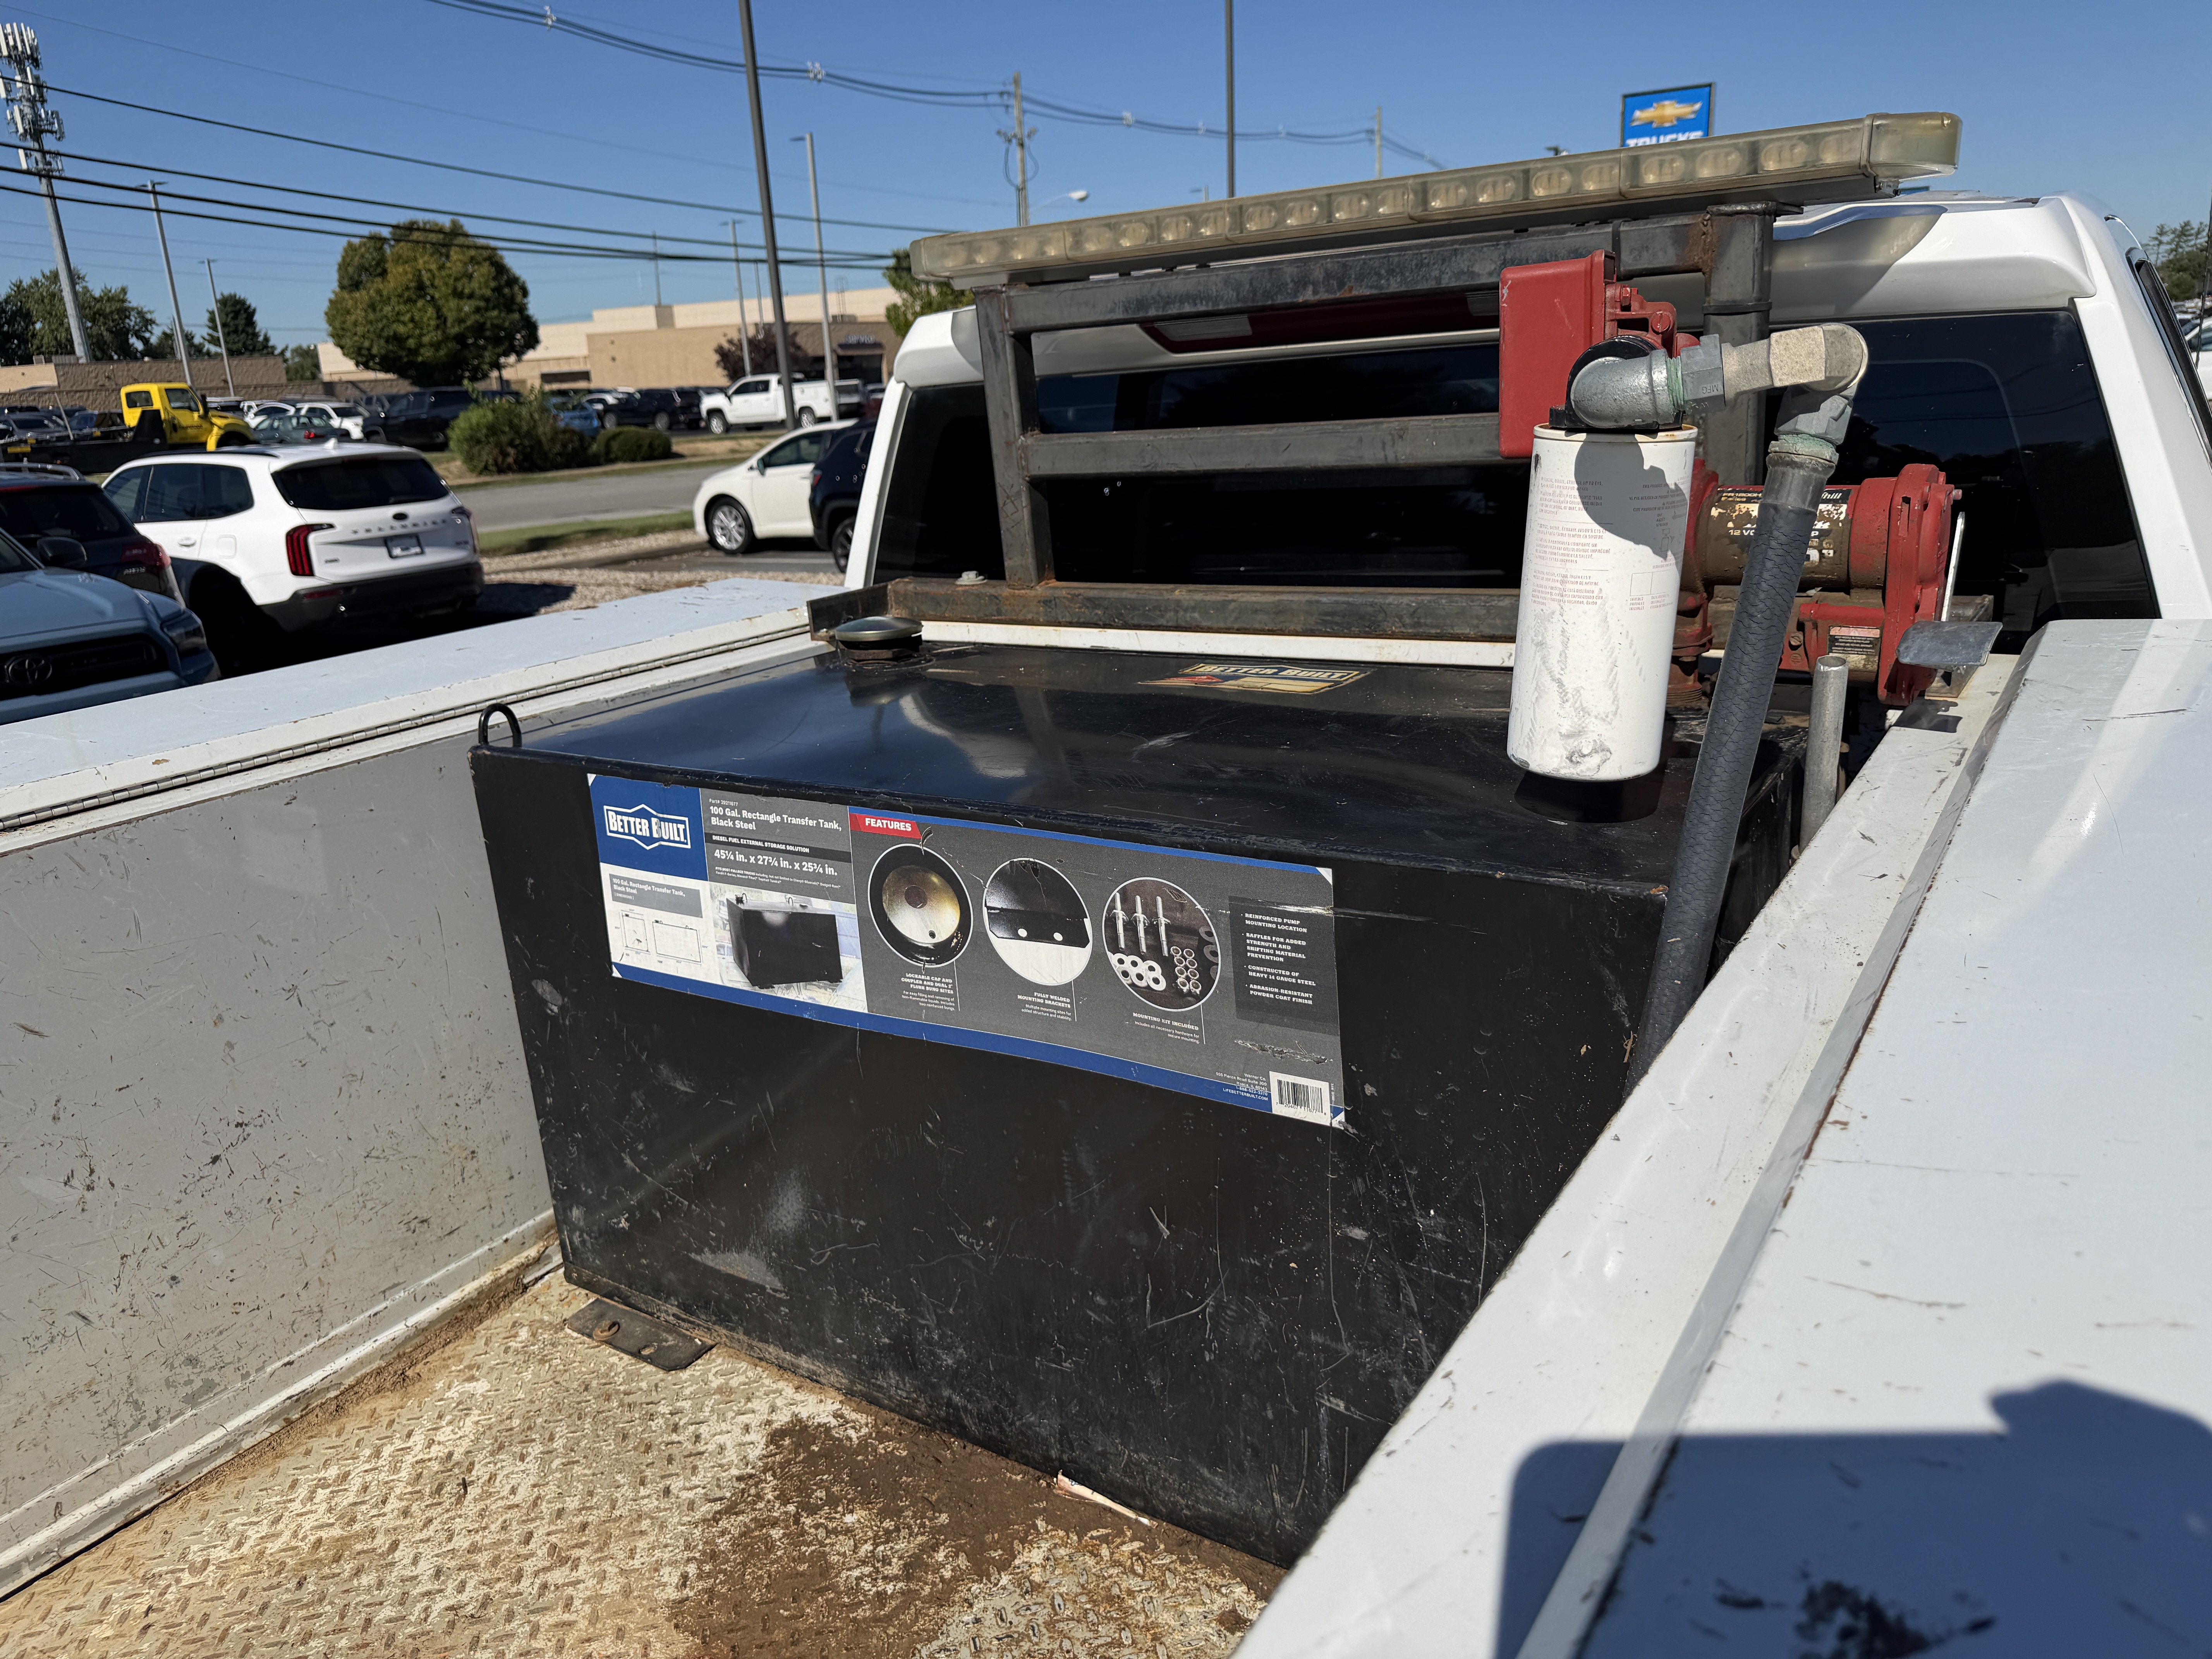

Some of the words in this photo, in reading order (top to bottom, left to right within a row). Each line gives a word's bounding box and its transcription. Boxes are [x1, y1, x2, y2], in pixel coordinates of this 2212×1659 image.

[1195, 666, 1278, 675] BETTER
[1278, 670, 1348, 679] BUILT
[608, 811, 650, 836] BETTER
[710, 806, 723, 815] 100
[725, 808, 740, 817] Gal.
[742, 810, 781, 823] Rectangle
[782, 814, 817, 826] Transfer
[818, 819, 842, 831] Tank,
[711, 817, 733, 827] Black
[735, 820, 756, 830] Steel
[865, 818, 912, 831] FEATURES
[736, 851, 747, 862] in.
[780, 857, 792, 869] in.
[794, 862, 800, 870] x
[825, 864, 837, 876] in.
[630, 881, 651, 891] Rectangle
[652, 886, 671, 894] Transfer
[672, 889, 685, 897] Tank,
[1245, 913, 1282, 922] REINFORCED
[1245, 920, 1276, 928] MOUNTING
[1278, 924, 1307, 933] LOCATION
[1246, 939, 1277, 948] STRENGTH
[1247, 952, 1284, 962] PREVENTION
[1275, 950, 1306, 958] MATERIAL
[1248, 965, 1290, 975] CONSTRUCTED
[1250, 984, 1313, 998] ABRASION-RESISTANT
[1017, 995, 1044, 1003] MOUNTING
[1045, 1000, 1071, 1008] BRACKETS
[1133, 1013, 1160, 1022] MOUNTING
[1172, 1021, 1199, 1030] INCLUDED
[1156, 1025, 1174, 1033] necessary
[1223, 1088, 1268, 1101] LIFEBETTERBUILT.COM
